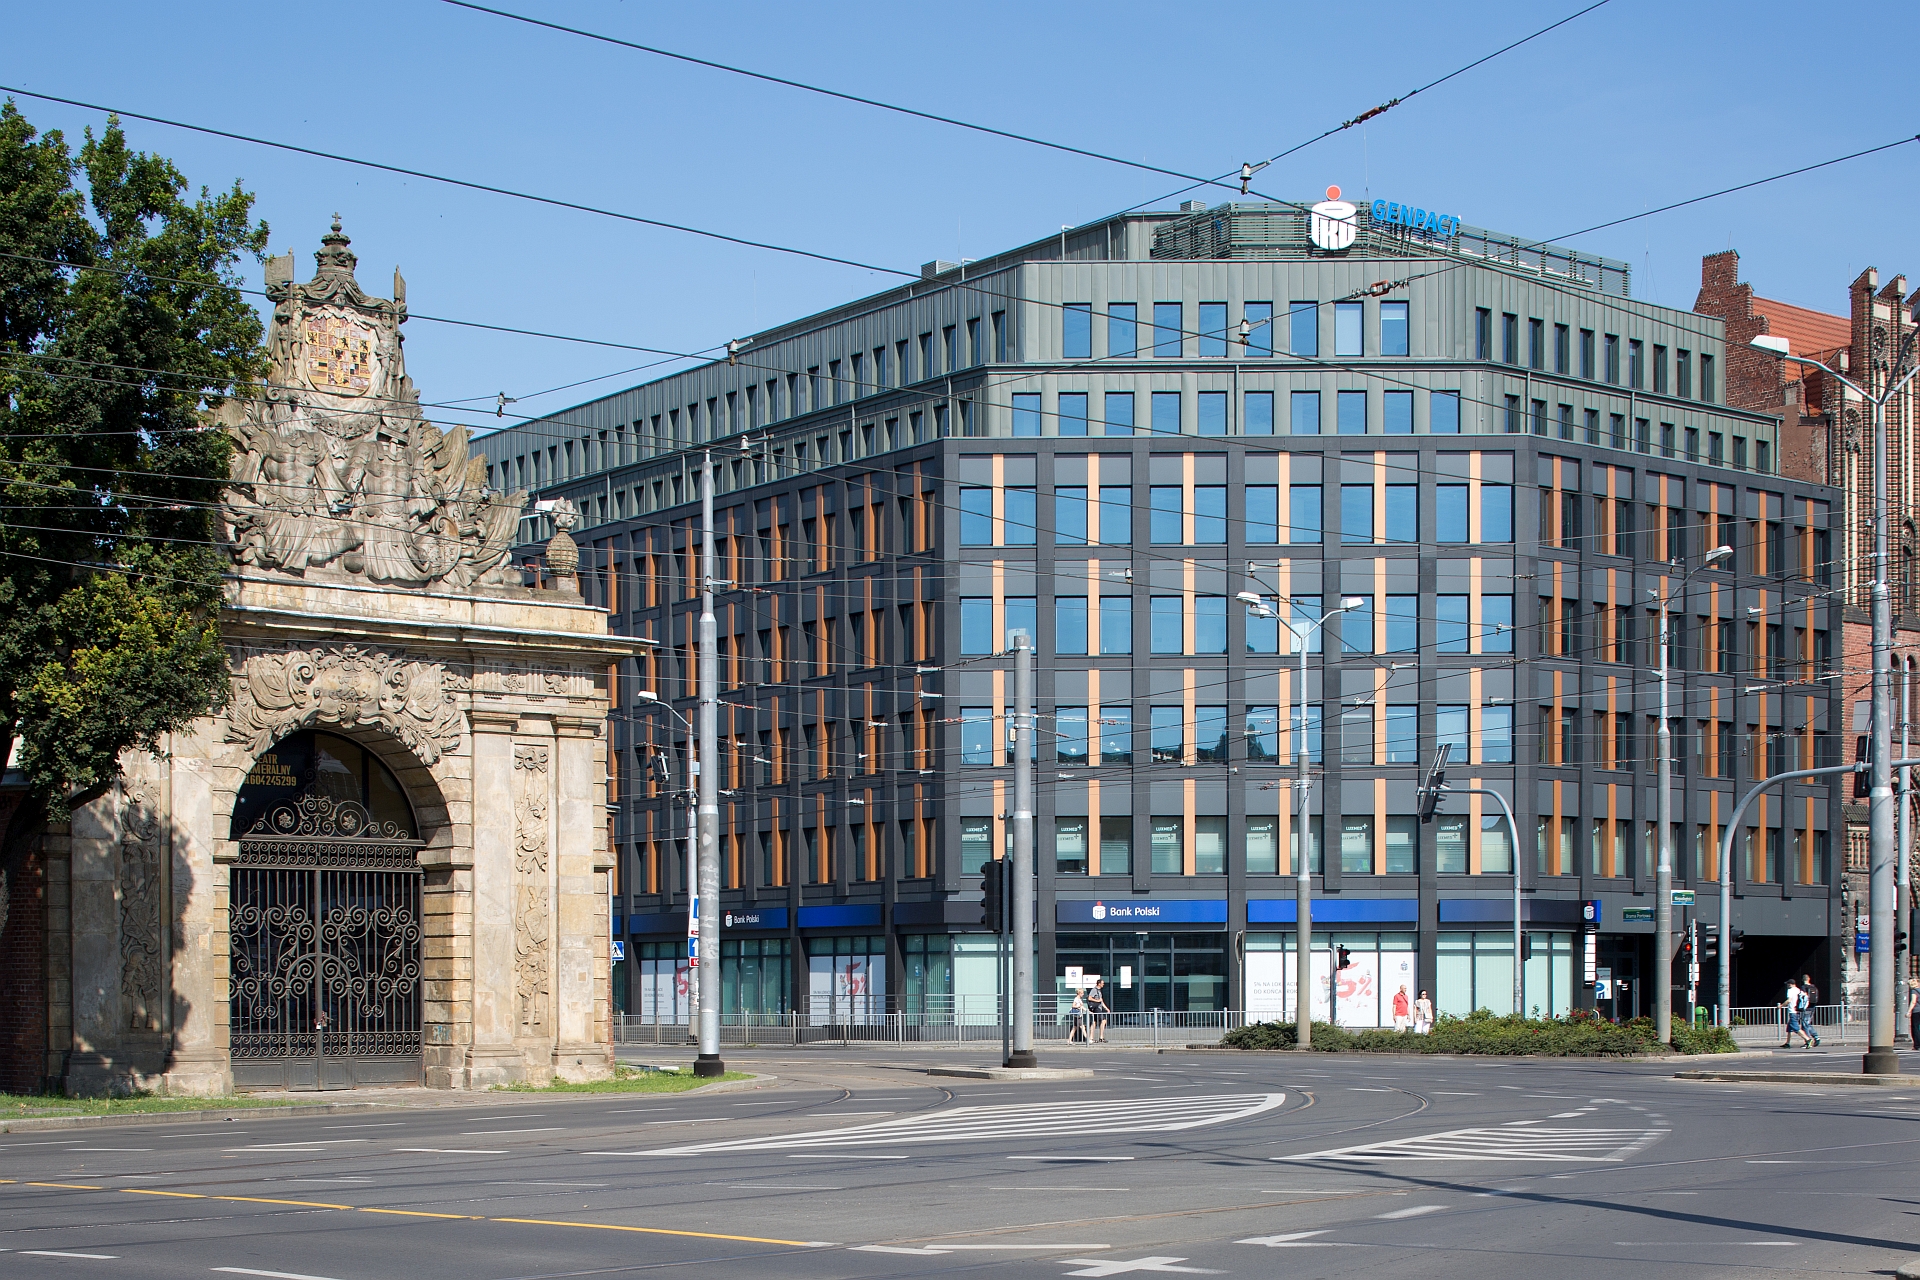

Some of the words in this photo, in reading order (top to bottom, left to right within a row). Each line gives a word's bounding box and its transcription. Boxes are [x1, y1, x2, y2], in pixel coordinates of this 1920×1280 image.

[1371, 199, 1460, 236] GENPACT
[257, 754, 278, 764] EATR
[250, 764, 291, 775] MERALNY
[1110, 907, 1132, 916] Bank
[1135, 907, 1160, 916] Polski
[746, 915, 759, 923] Polski
